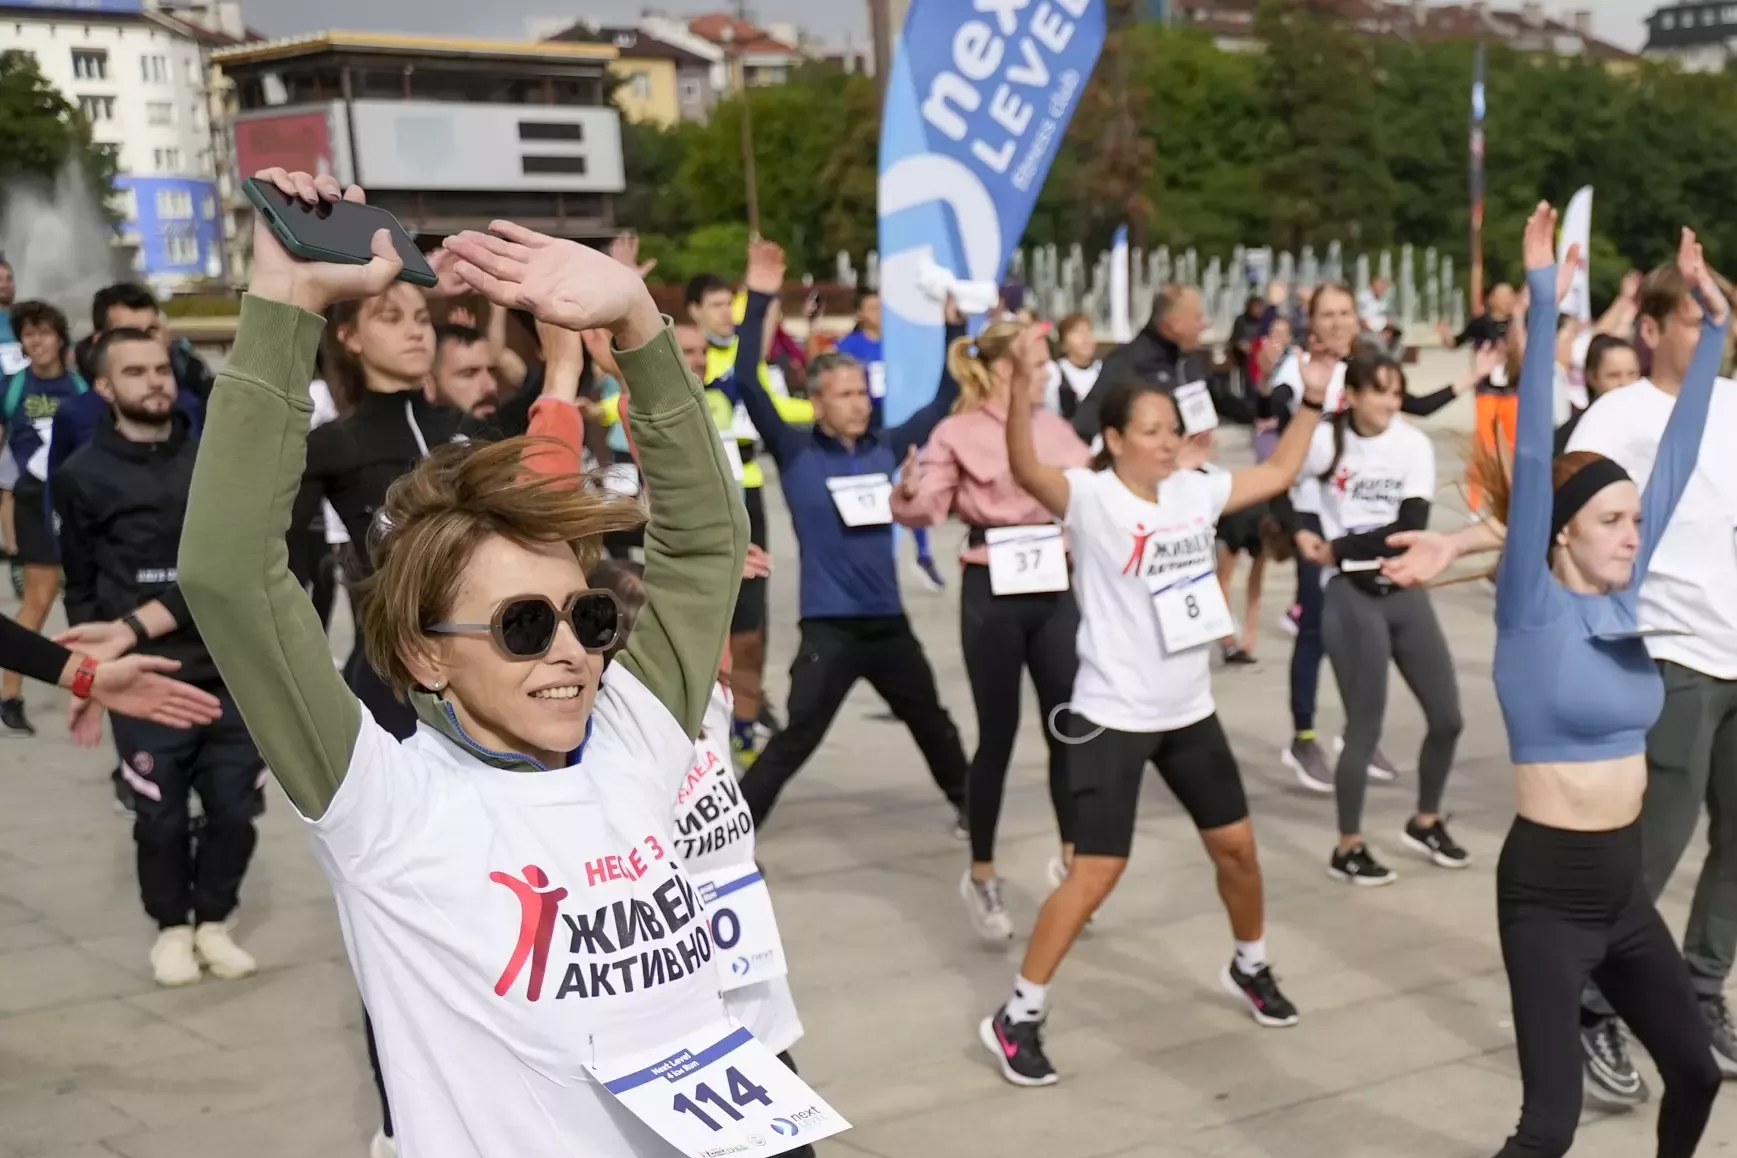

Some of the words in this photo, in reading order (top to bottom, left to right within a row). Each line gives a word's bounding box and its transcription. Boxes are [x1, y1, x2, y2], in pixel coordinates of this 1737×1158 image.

[1014, 548, 1043, 573] 37
[1184, 593, 1200, 619] 8
[674, 811, 752, 860] ТИВНО
[562, 861, 704, 955] ЖИВЕЙ
[555, 925, 711, 1000] АКТИВНО
[673, 1066, 773, 1131] 114
